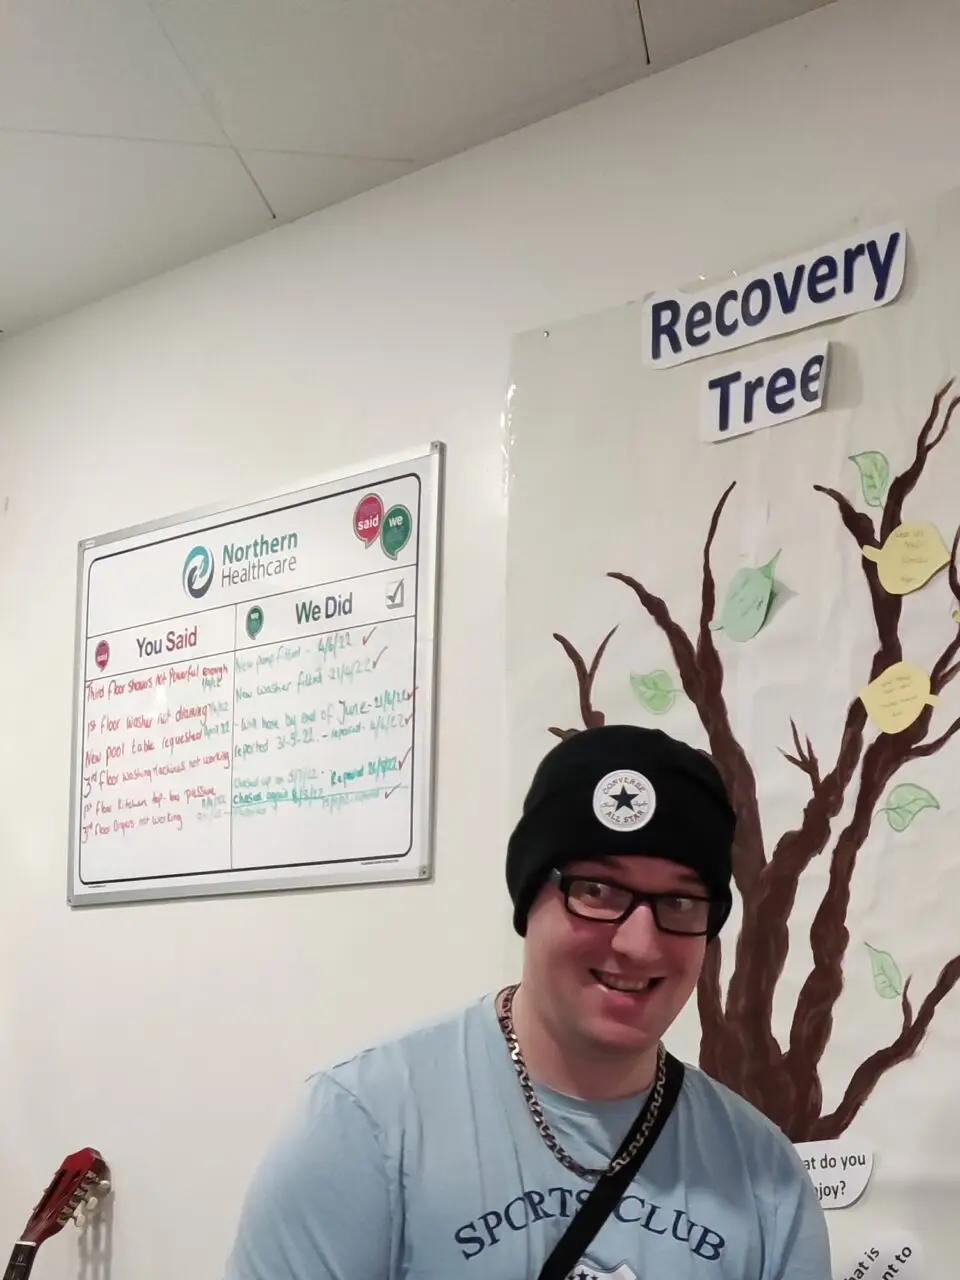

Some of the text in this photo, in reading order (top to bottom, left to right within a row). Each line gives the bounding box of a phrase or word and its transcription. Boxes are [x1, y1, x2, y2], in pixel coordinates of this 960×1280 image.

[652, 232, 900, 360] Recovery
[708, 354, 825, 432] Tree
[357, 514, 379, 531] said
[388, 515, 404, 528] we
[222, 532, 298, 566] Northern
[221, 557, 298, 588] Healthcare
[296, 592, 354, 625] We Did
[137, 626, 198, 658] You Said
[257, 680, 292, 696] washer
[106, 742, 125, 766] pool
[605, 809, 645, 823] ALL STAR
[803, 1153, 866, 1171] at do you
[815, 1180, 846, 1201] joy?
[454, 1187, 726, 1261] SPORTS CLUB
[864, 1246, 880, 1262] is
[895, 1245, 912, 1264] to
